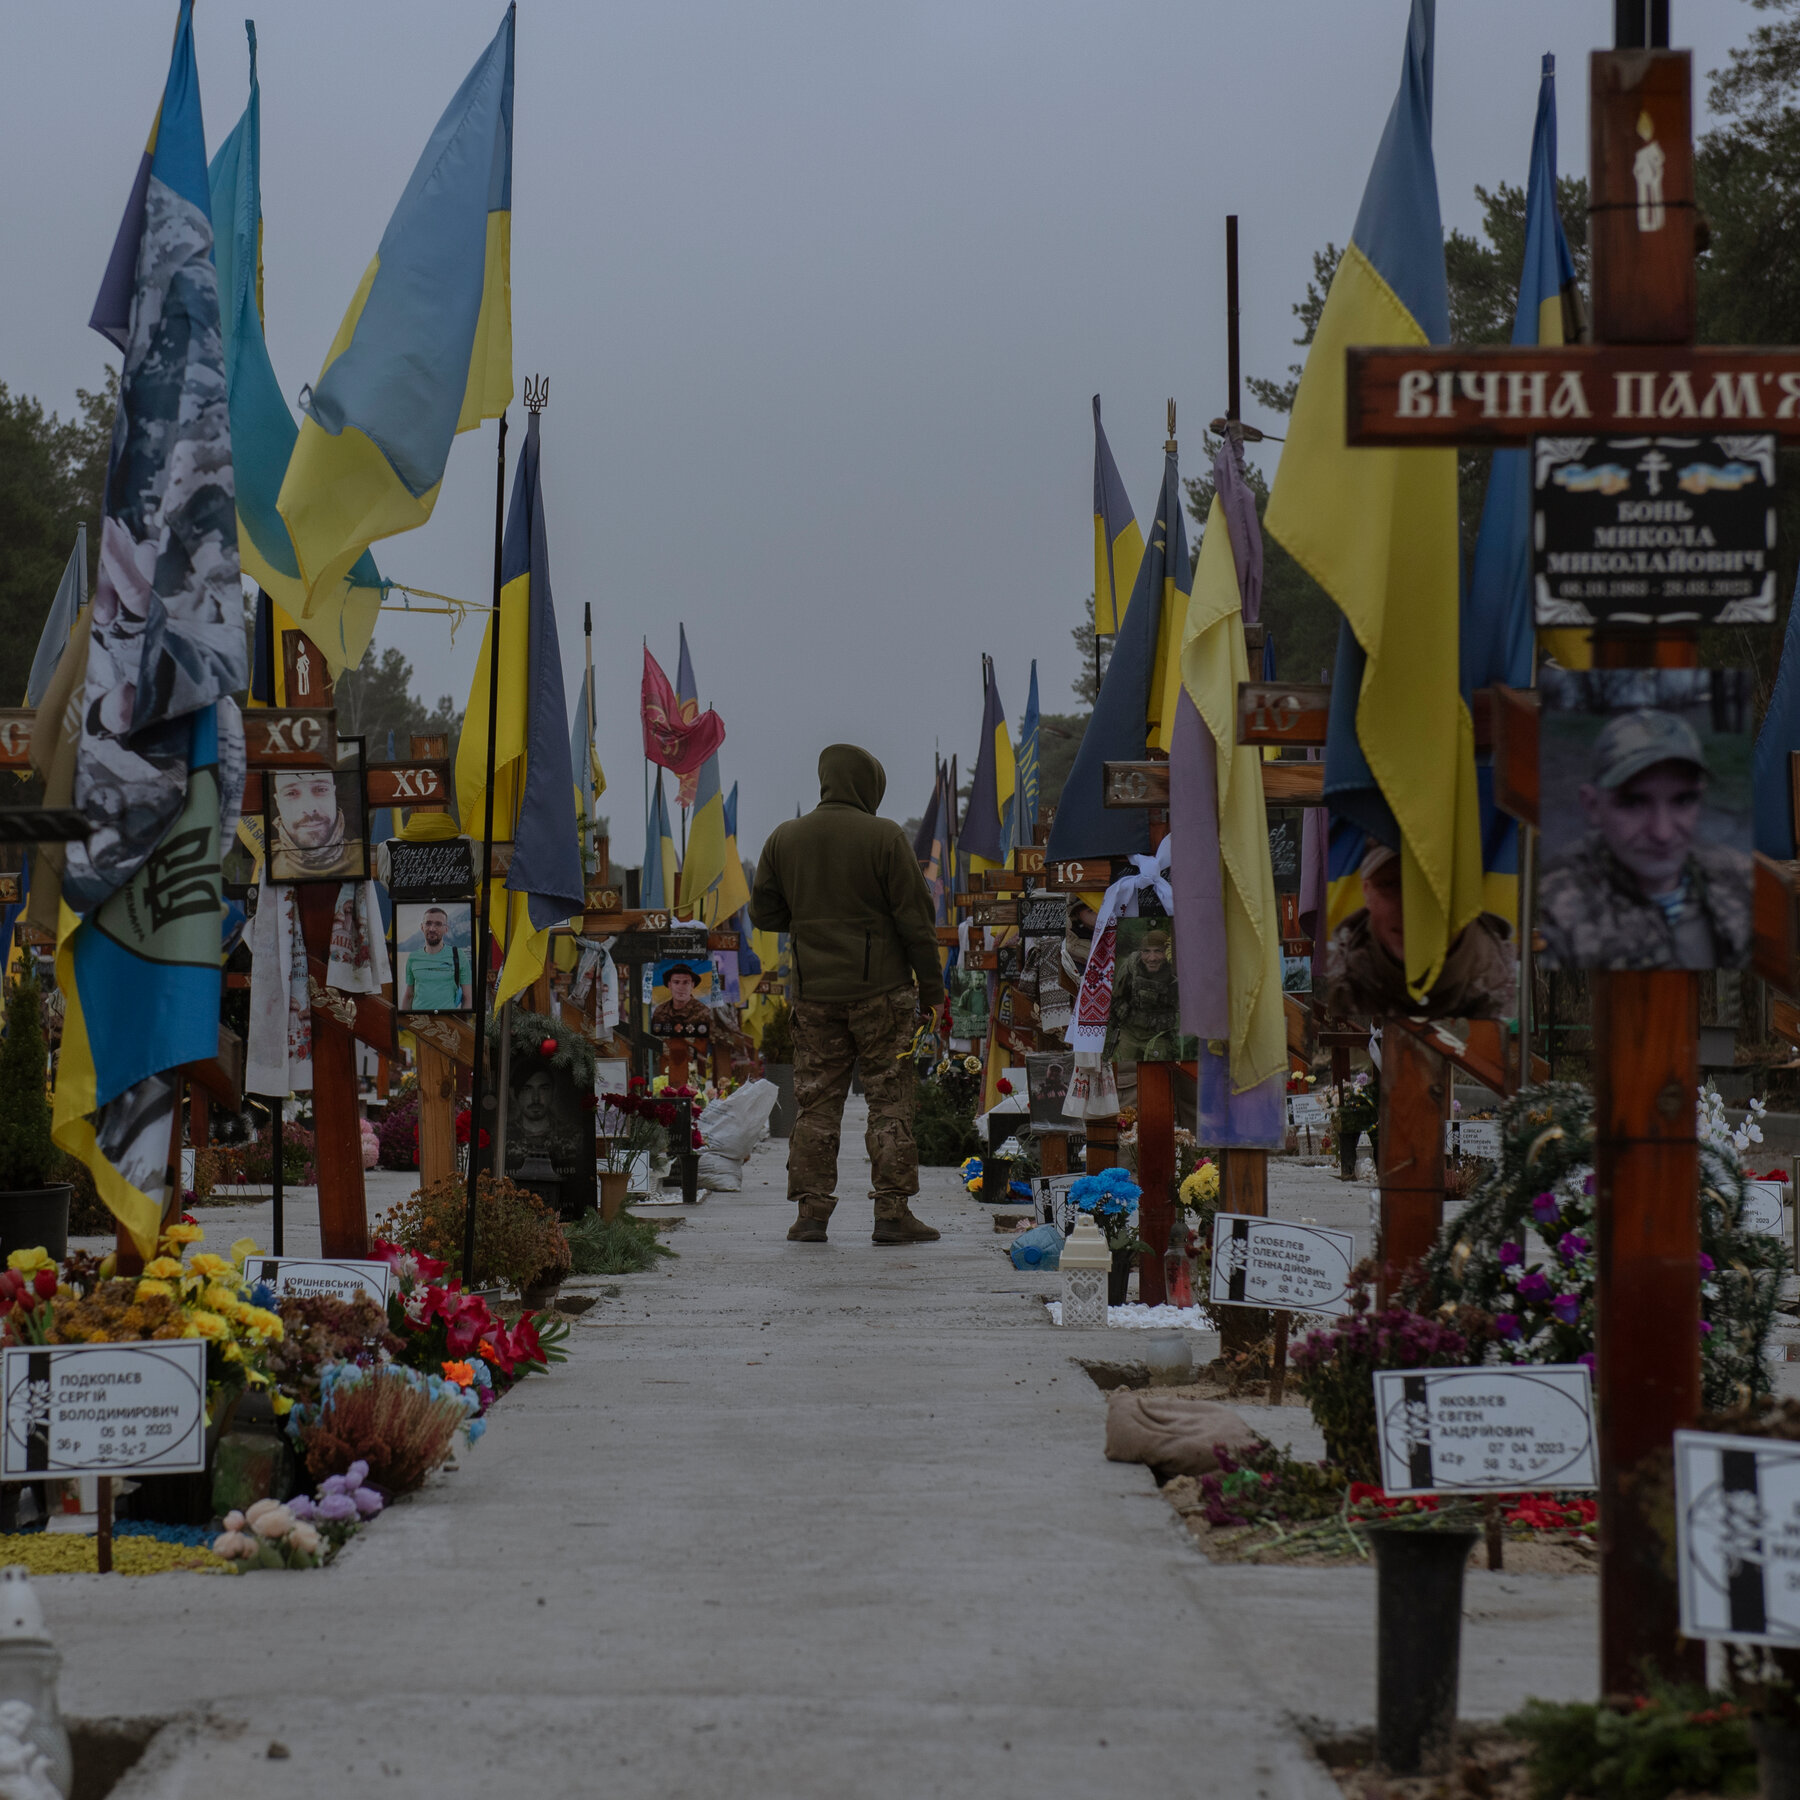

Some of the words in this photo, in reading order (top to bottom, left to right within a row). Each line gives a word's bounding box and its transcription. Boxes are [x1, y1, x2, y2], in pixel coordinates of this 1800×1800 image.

[1395, 369, 1594, 419] ВІЧНА
[1617, 500, 1694, 523] БОНЬ
[1594, 526, 1718, 548] МИКОЛА
[1547, 549, 1765, 574] МИКОЛАЙОВИЧ
[1253, 1236, 1304, 1250] СКОБЕЛЄВ
[1252, 1247, 1311, 1263] ОЛЕКСАНДР
[1253, 1259, 1326, 1278] ГЕННАДІЙОВИЧ
[1312, 1279, 1332, 1290] 2023
[60, 1372, 142, 1387] ПОДКОПАЄВ
[58, 1389, 107, 1403] СЕРГІЙ
[1439, 1396, 1506, 1407] ЯКОВЛЄВ
[58, 1406, 179, 1422] ВОЛОДИМИРОВИЧ
[1437, 1410, 1483, 1422] ЄВГЕН
[101, 1426, 115, 1437] 05
[122, 1425, 137, 1437] 04
[145, 1422, 173, 1436] 2023
[1439, 1424, 1535, 1438] АНДРІЙОВИЧ
[1488, 1442, 1504, 1454] 07
[1511, 1442, 1528, 1454] 04
[1534, 1442, 1565, 1454] 2023
